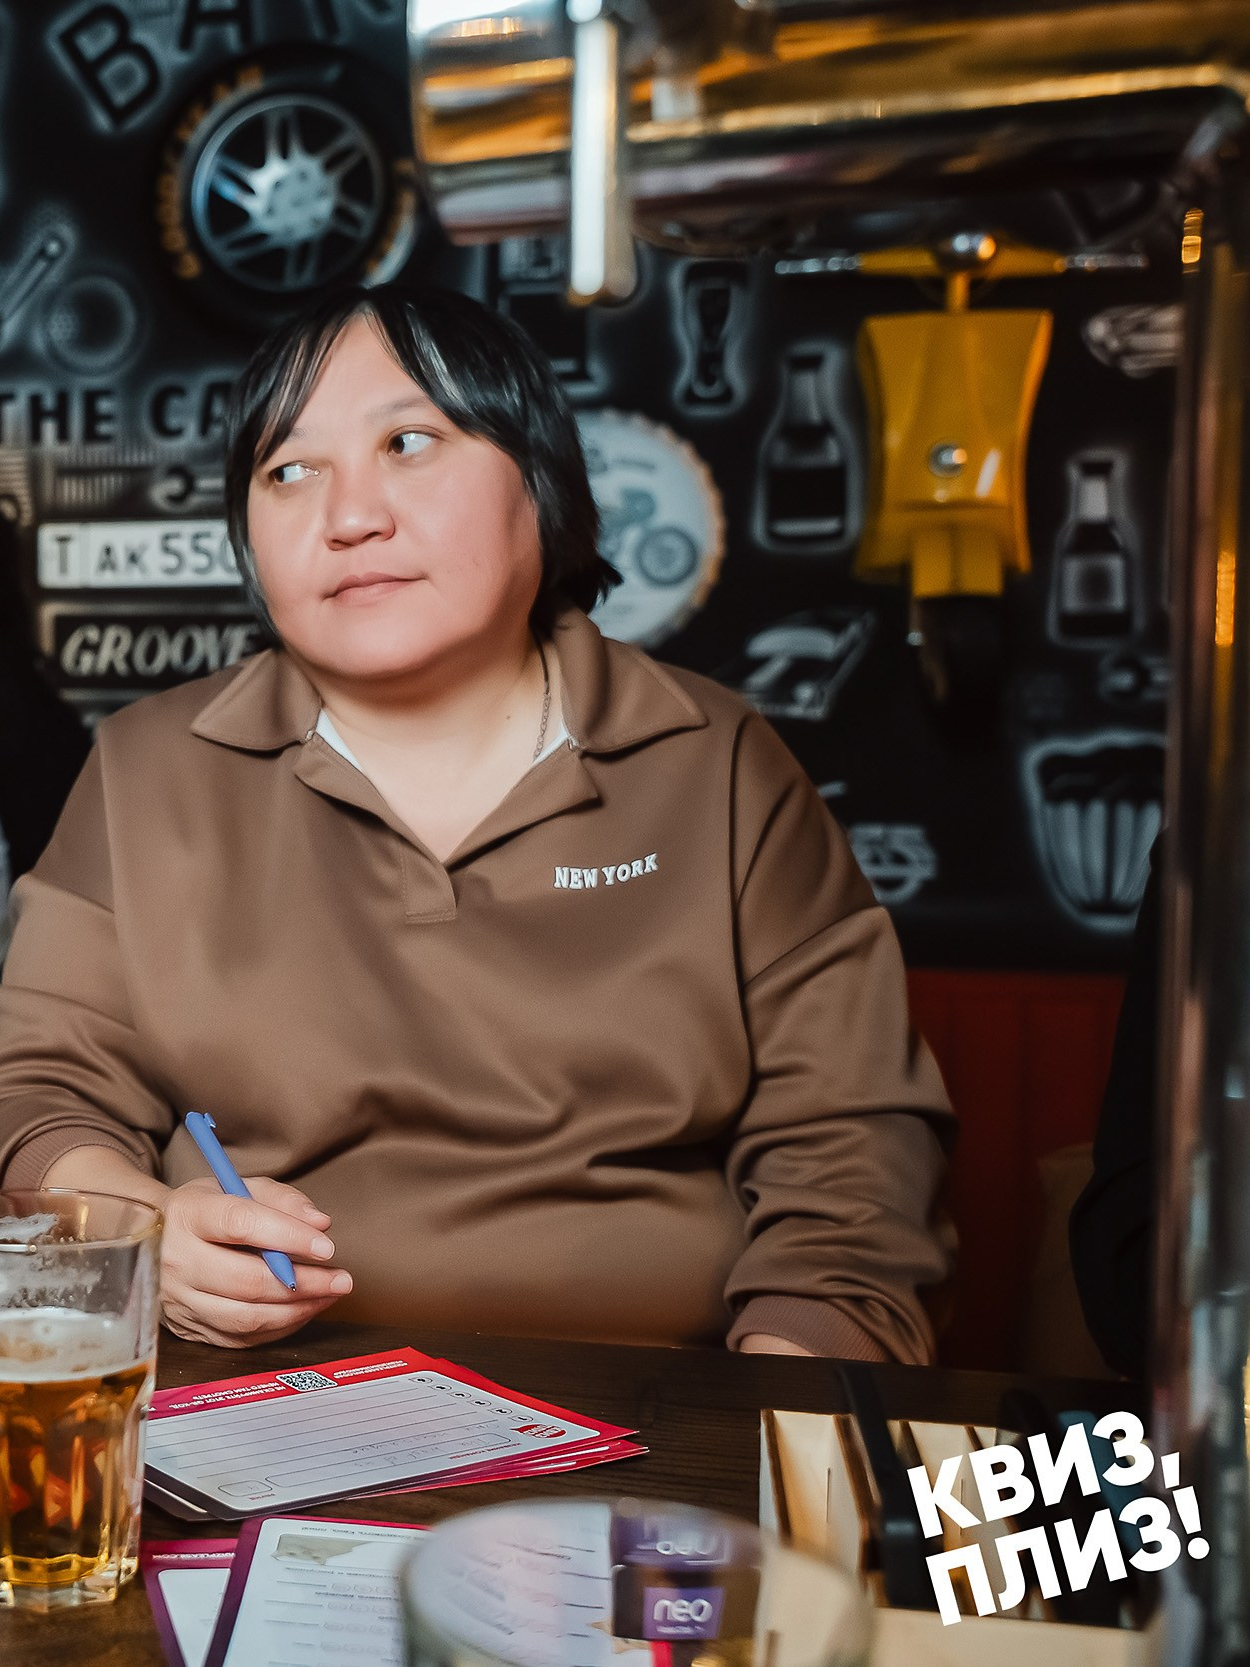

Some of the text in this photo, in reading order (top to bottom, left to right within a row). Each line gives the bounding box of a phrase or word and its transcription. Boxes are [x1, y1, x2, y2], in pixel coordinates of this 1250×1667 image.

[553, 852, 658, 890] NEW YORK
[653, 1598, 713, 1623] neo
